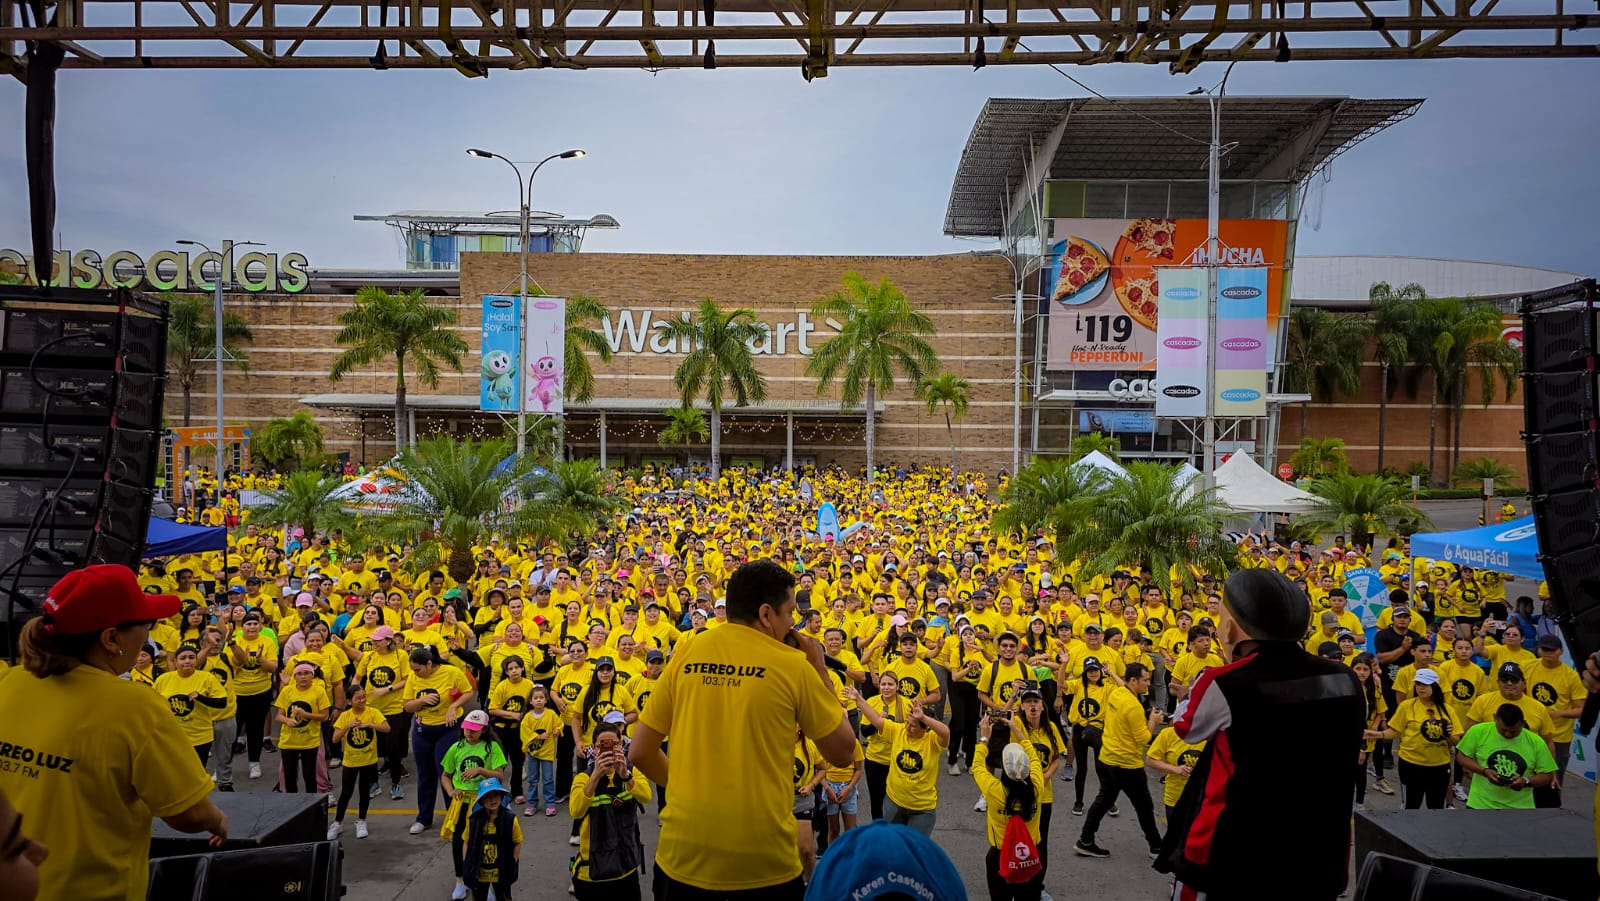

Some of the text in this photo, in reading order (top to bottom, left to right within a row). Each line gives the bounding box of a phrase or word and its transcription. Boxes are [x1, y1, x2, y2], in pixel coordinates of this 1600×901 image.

[1166, 289, 1201, 298] cascadas
[1222, 288, 1260, 297] cascadas
[484, 322, 501, 334] Soy
[602, 309, 815, 355] Walart
[1085, 314, 1133, 343] 119
[1165, 338, 1200, 347] cascadas
[1222, 339, 1259, 349] cascadas
[1070, 351, 1144, 363] PEPPERONI
[1165, 386, 1199, 396] cascadas
[1222, 389, 1259, 399] cascadas
[1454, 544, 1509, 567] AquaFácil
[684, 663, 766, 678] STEREO LUZ
[702, 676, 741, 688] 103.7 FM
[0, 741, 74, 773] REO LUZ
[22, 766, 40, 780] FM
[852, 871, 934, 901] Karen Castejon
